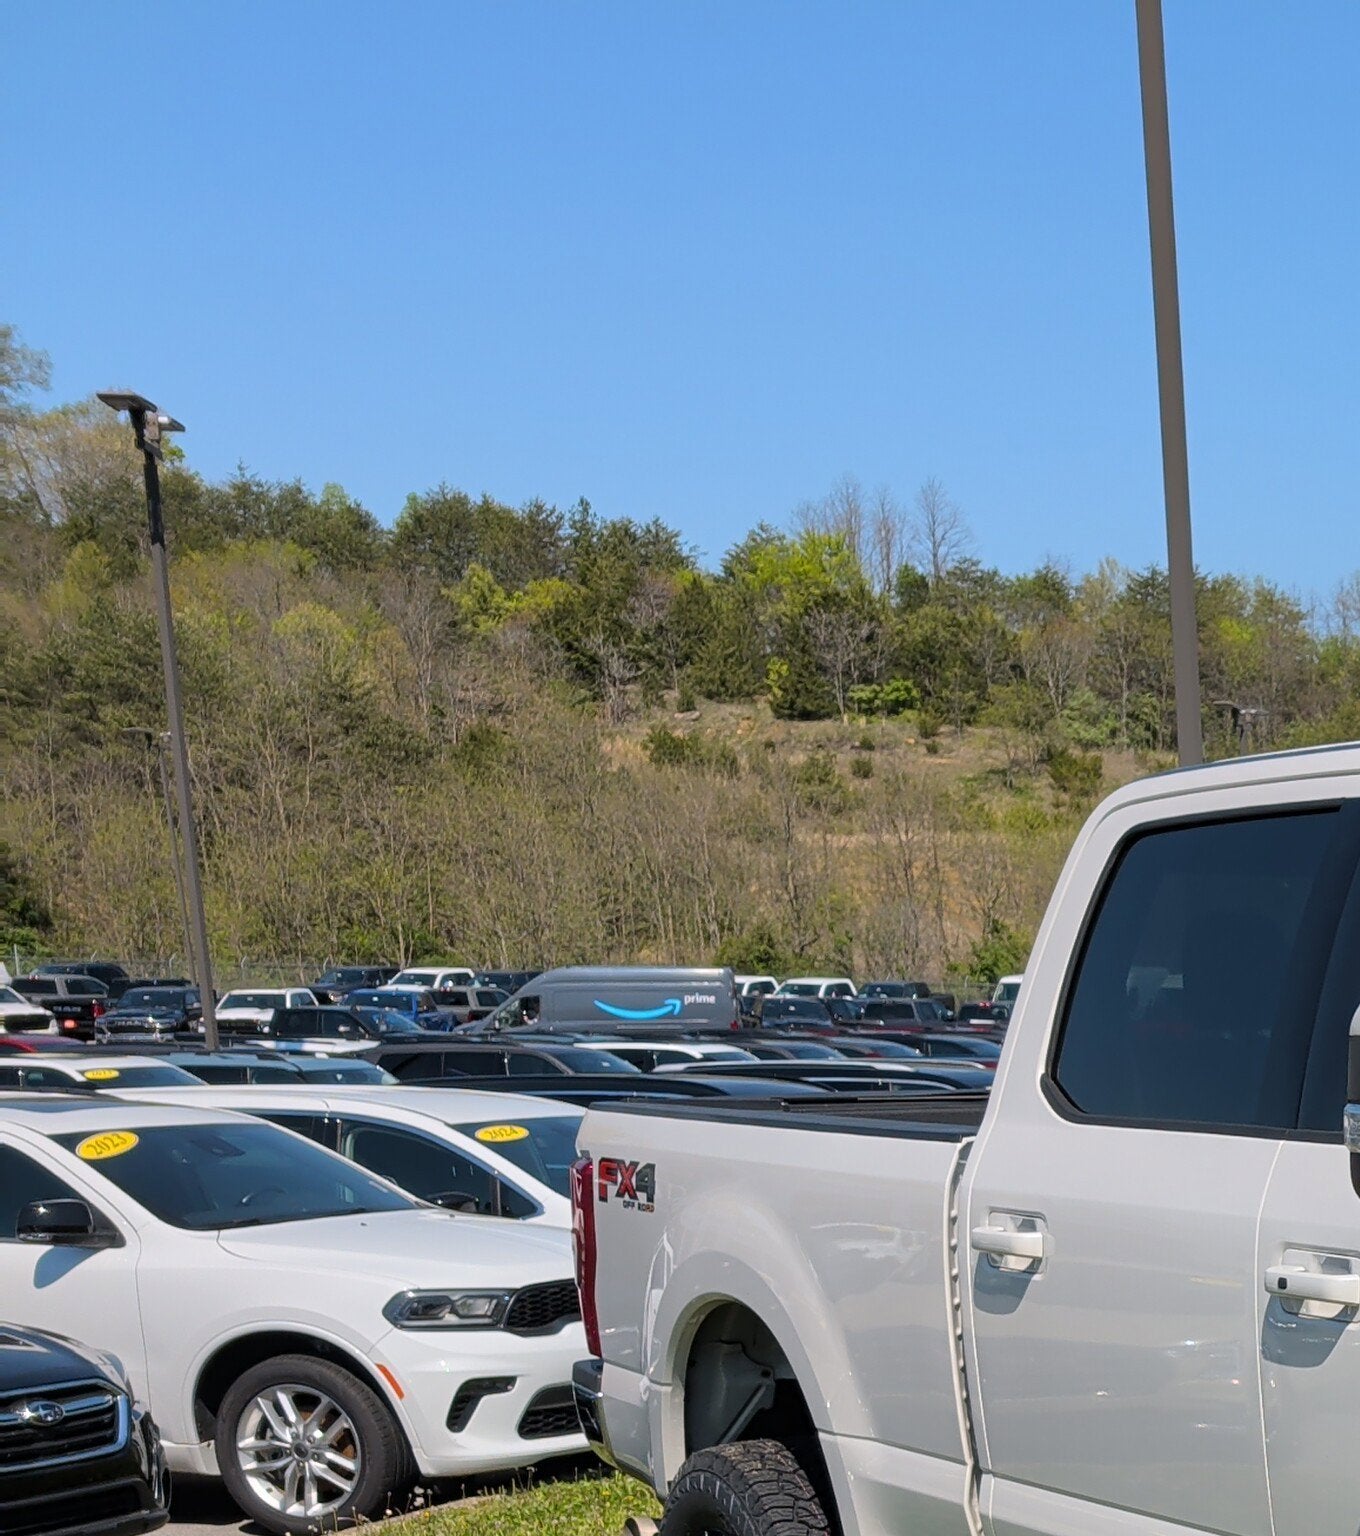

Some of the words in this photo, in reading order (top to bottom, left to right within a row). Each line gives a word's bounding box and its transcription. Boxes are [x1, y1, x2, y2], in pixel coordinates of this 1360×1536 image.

[684, 992, 716, 1006] prime
[85, 1133, 128, 1155] 2023
[598, 1157, 656, 1203] FX4
